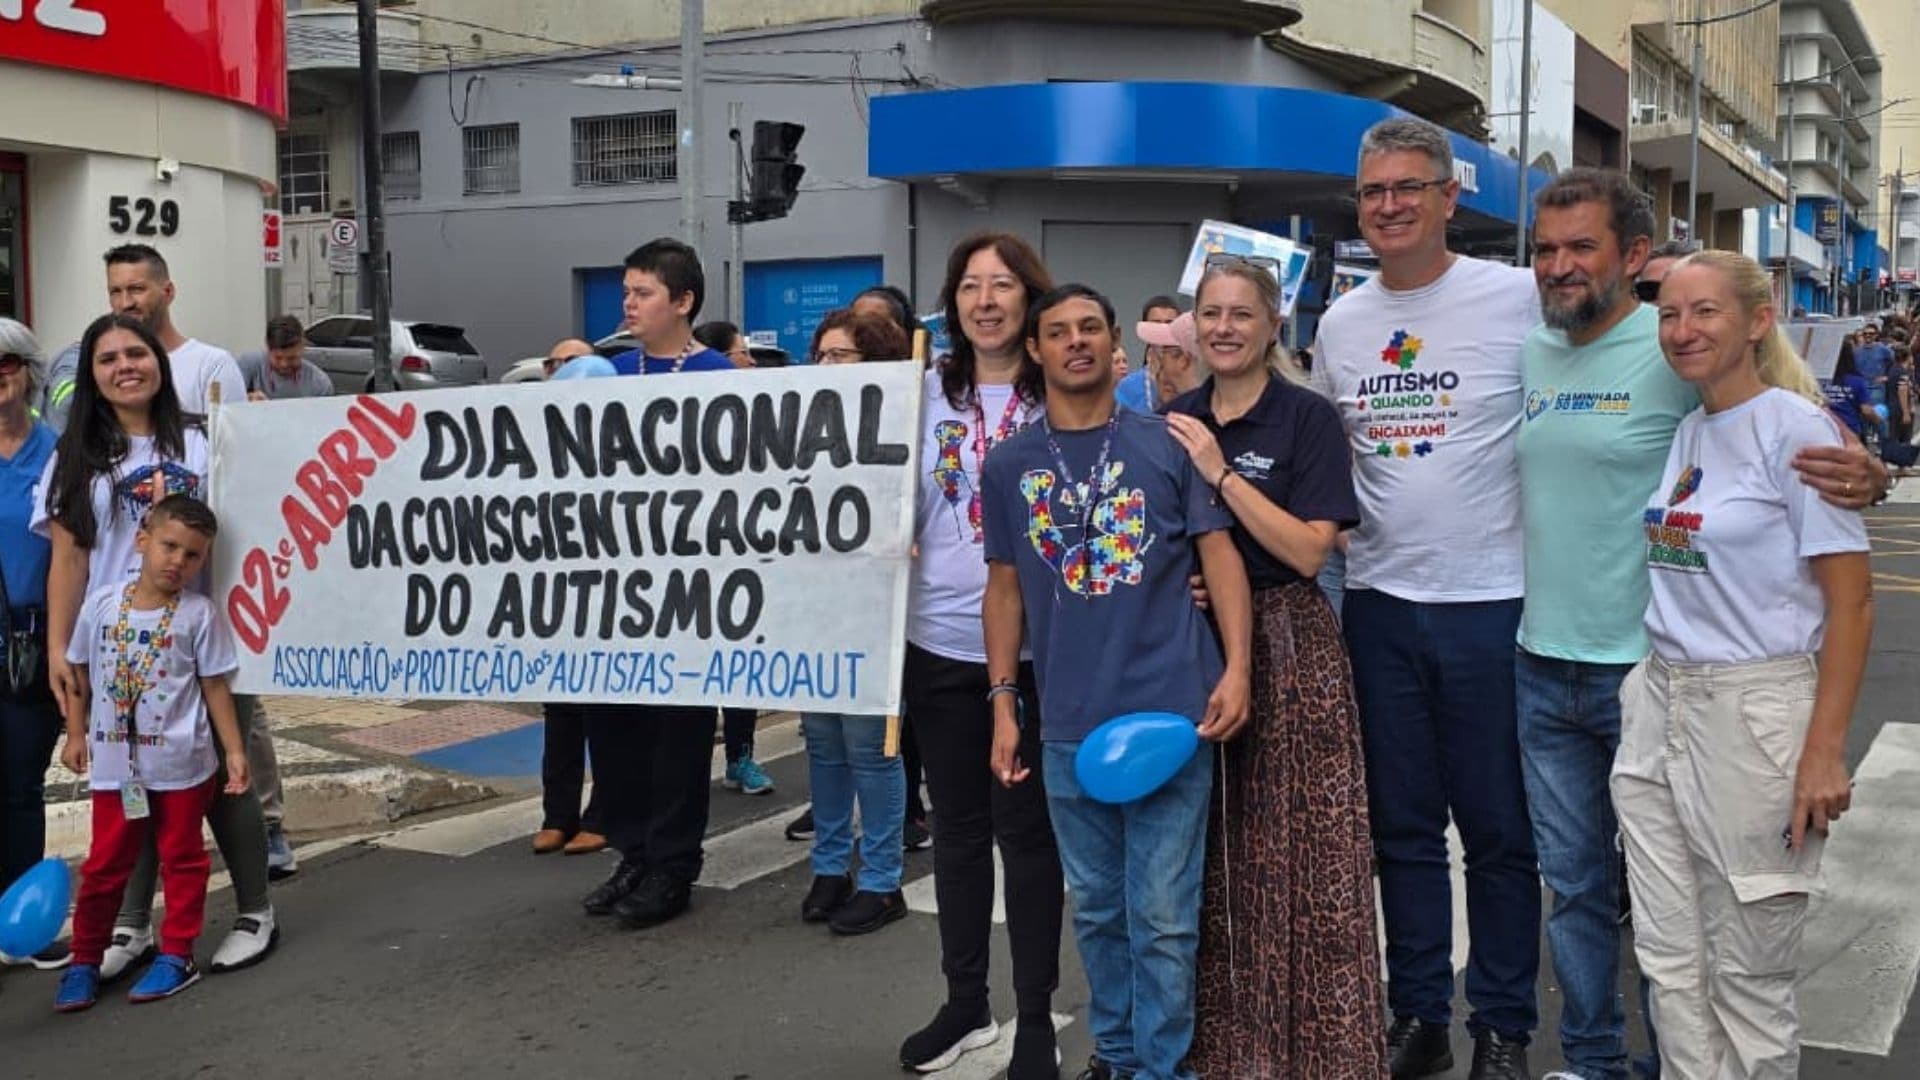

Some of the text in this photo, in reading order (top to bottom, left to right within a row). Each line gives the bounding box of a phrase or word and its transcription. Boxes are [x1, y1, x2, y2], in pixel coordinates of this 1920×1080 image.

[109, 195, 179, 237] 529
[339, 225, 350, 241] E
[1357, 371, 1460, 398] AUTISMO
[1370, 394, 1434, 410] QUANDO
[420, 383, 910, 481] DIA NACIONAL
[1368, 423, 1446, 440] ENCAIXAM!
[228, 394, 417, 654] 02 de ABRIL
[347, 475, 871, 568] DA CONSCIENTIZAÇÃO
[404, 572, 471, 637] DO
[272, 642, 390, 695] ASSOCIAÇÃO
[404, 643, 524, 696] PROTEÇÃO
[547, 651, 676, 695] AUTISTAS
[702, 649, 866, 700] APROAUT
